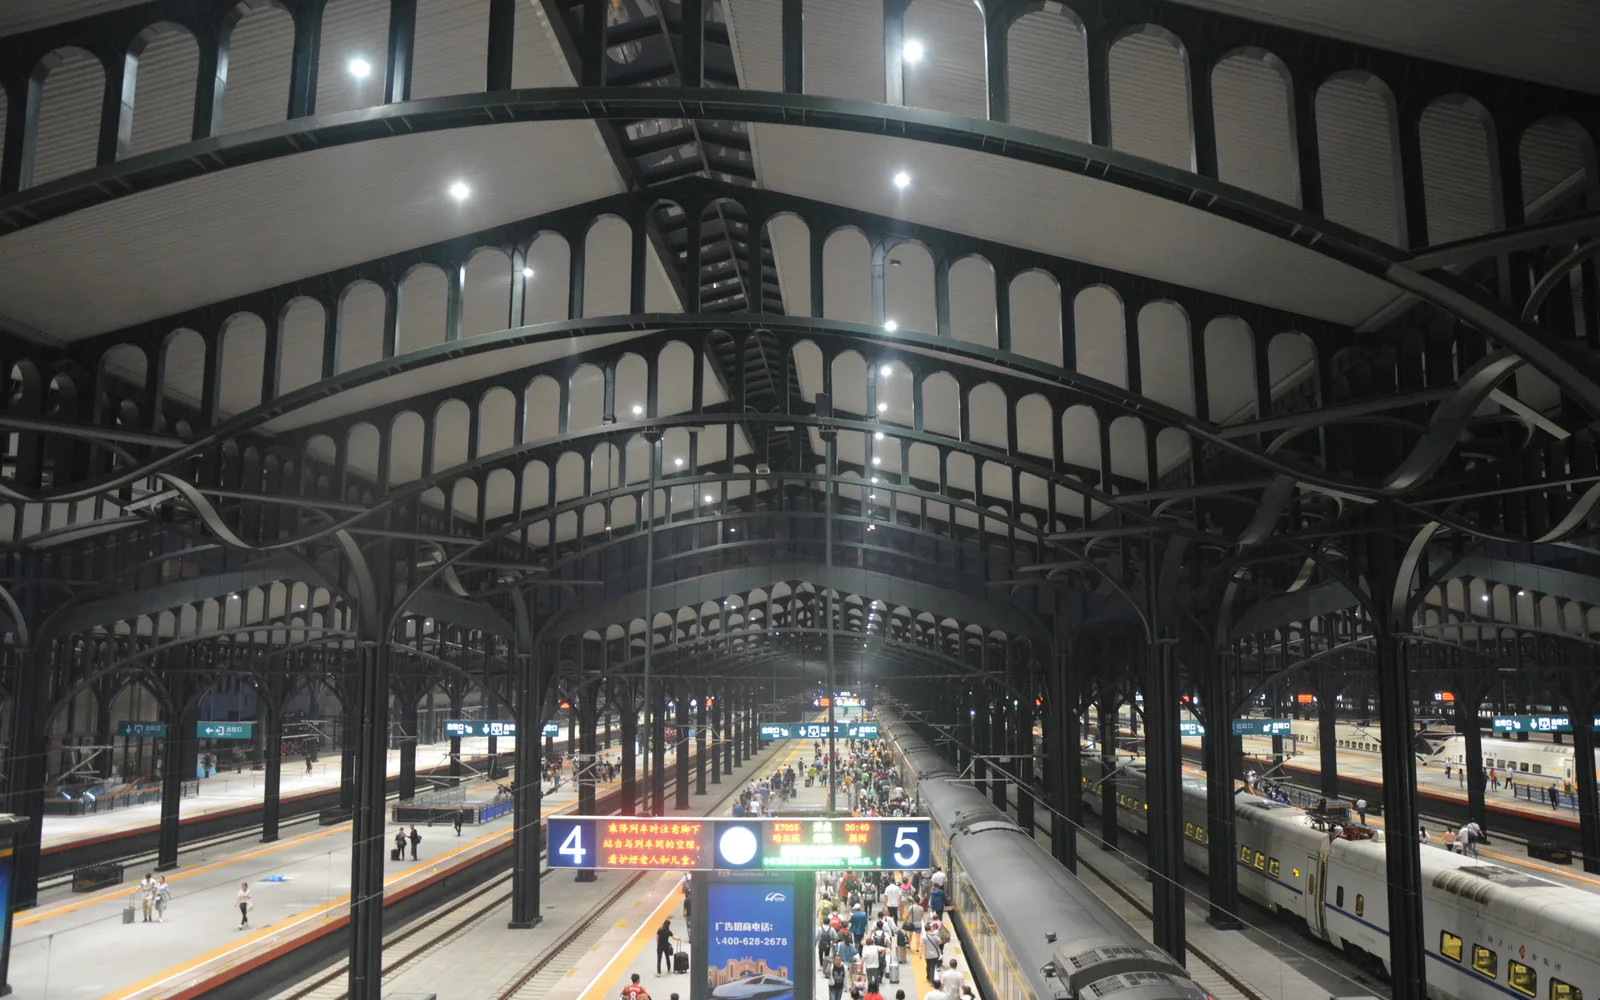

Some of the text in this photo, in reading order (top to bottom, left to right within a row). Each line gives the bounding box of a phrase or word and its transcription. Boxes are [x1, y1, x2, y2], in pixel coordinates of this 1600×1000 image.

[844, 823, 870, 832] 20:40
[772, 833, 801, 843] 哈尔滨
[558, 824, 587, 865] 4
[893, 826, 920, 866] 5
[721, 937, 788, 946] 400-628-2678
